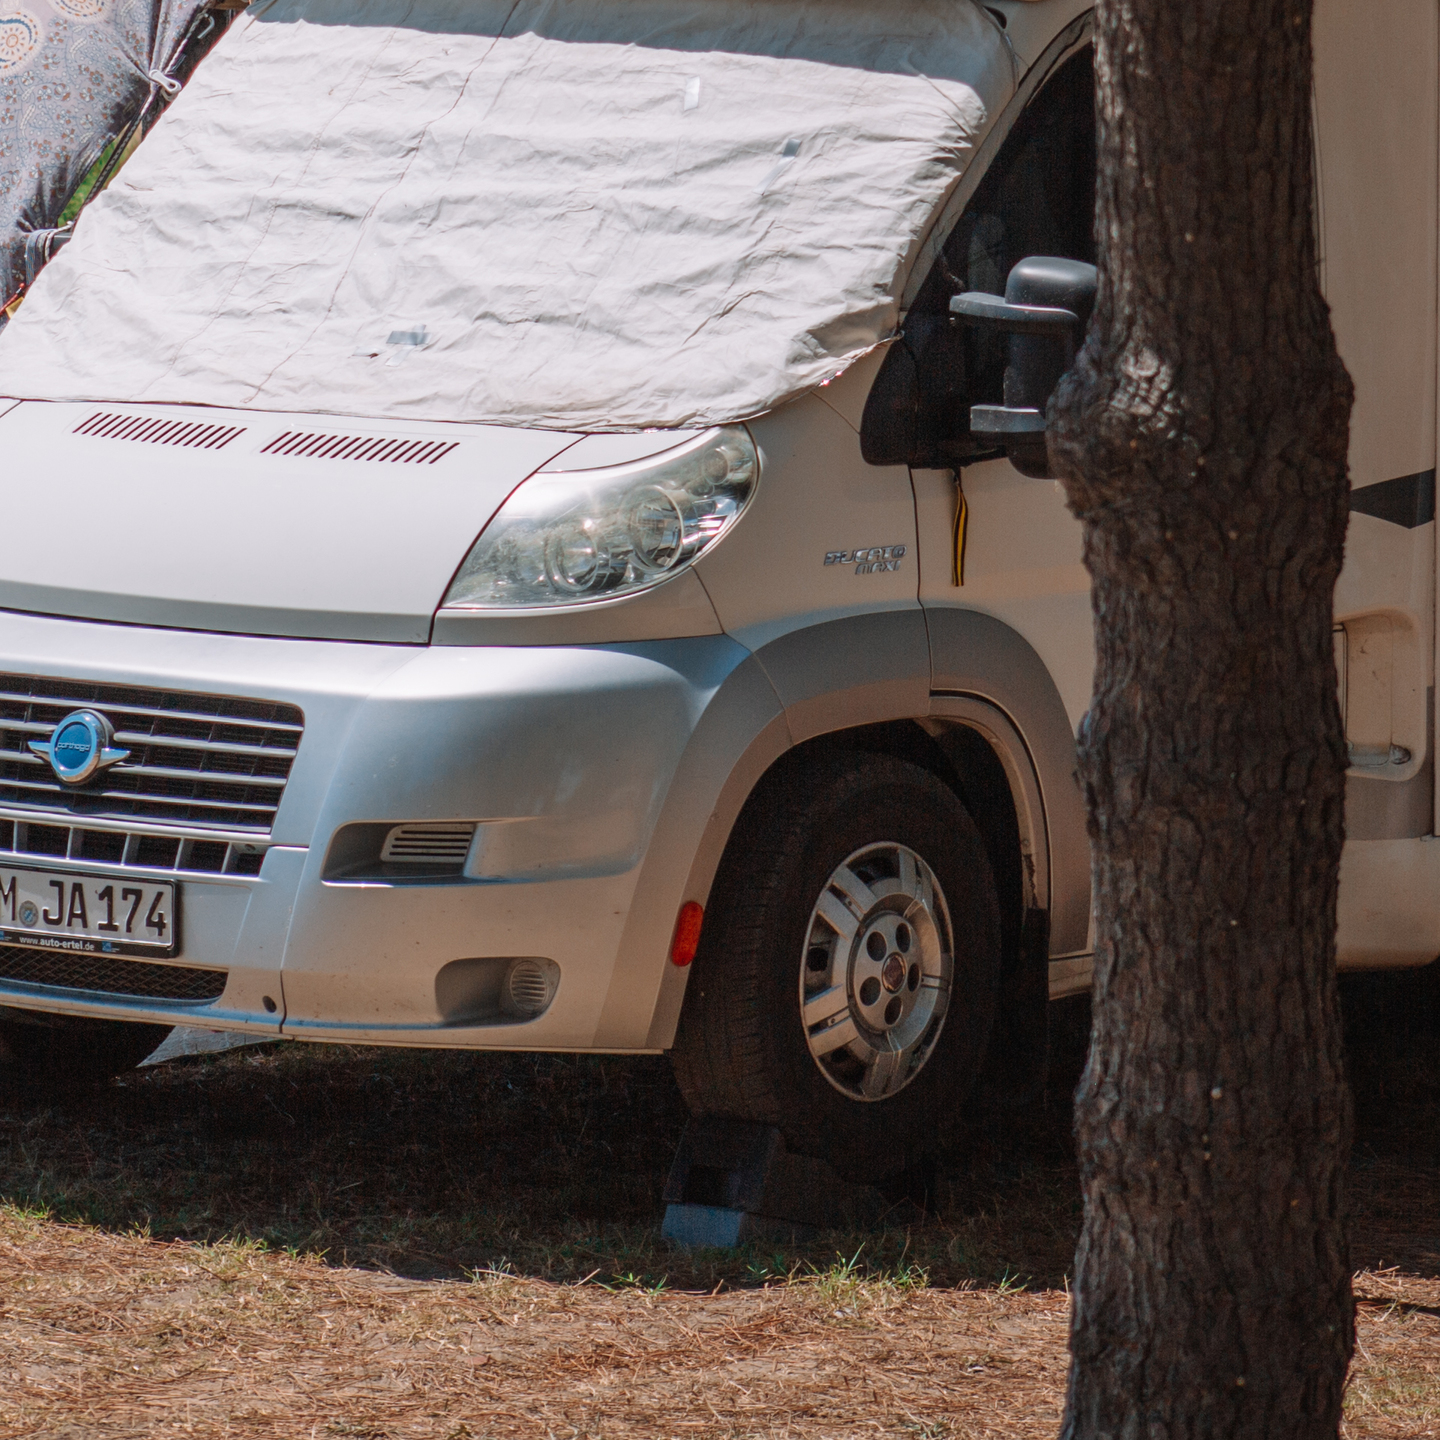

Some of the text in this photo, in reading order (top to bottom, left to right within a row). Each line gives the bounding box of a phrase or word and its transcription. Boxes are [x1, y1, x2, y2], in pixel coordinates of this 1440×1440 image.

[824, 545, 907, 566] DUCATO
[855, 561, 901, 575] MAXI
[42, 880, 88, 928] JA
[98, 885, 166, 936] 174
[19, 936, 95, 951] www.auto-ertel.de
